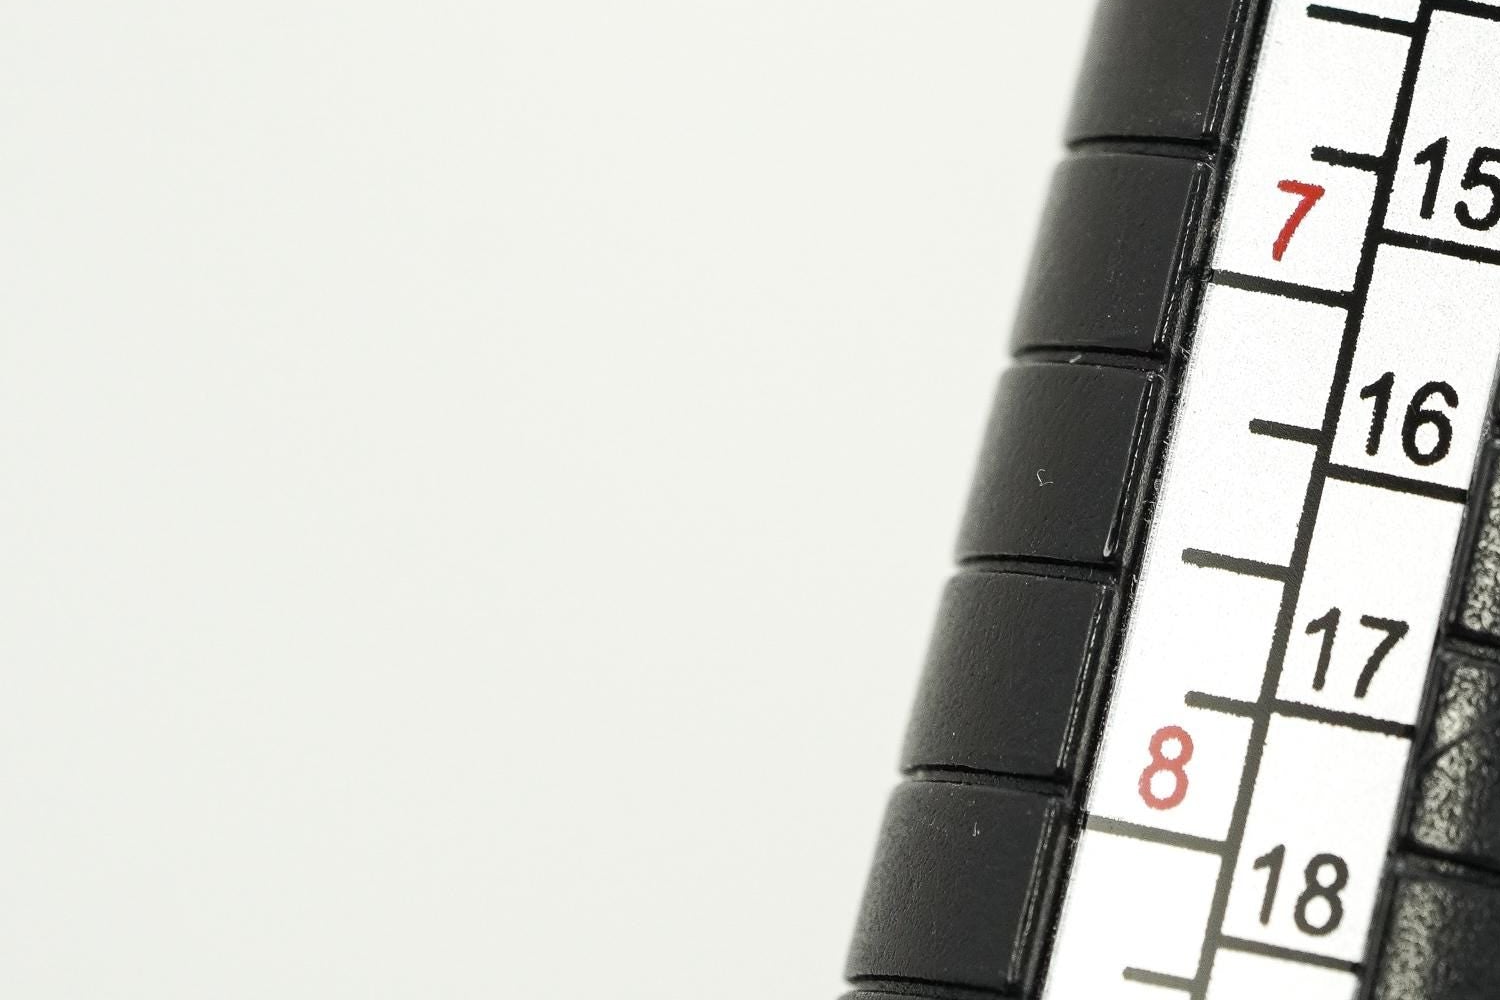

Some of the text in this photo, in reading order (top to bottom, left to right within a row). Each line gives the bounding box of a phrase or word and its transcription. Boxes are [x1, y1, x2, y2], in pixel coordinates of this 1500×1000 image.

[1272, 179, 1325, 262] 7
[1359, 372, 1460, 466] 16
[1305, 607, 1410, 699] 17
[1138, 725, 1195, 811] 8
[1252, 844, 1350, 937] 18
